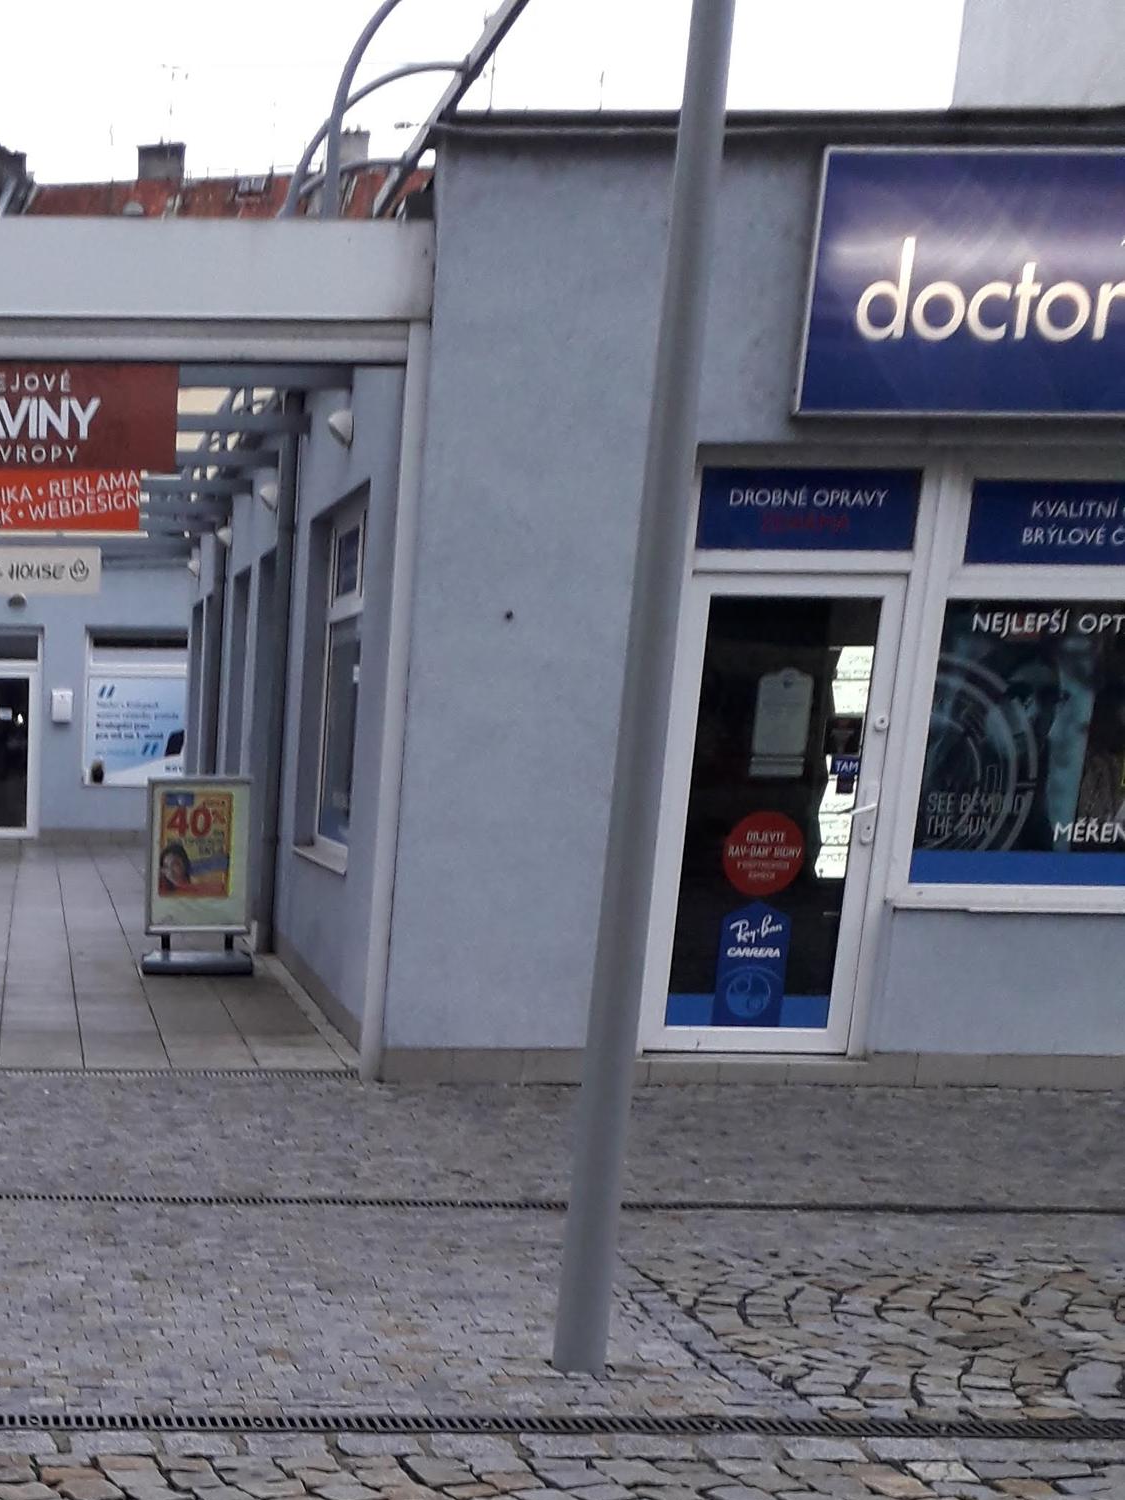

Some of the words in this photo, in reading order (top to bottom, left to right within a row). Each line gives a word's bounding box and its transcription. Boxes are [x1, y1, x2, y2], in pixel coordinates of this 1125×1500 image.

[49, 469, 140, 498] REKLAMA
[29, 491, 140, 522] WEBDESIGN
[729, 484, 807, 507] DROBNÉ
[813, 488, 889, 508] OPRAVY
[1031, 497, 1120, 518] KVALITNÍ
[1021, 523, 1107, 545] BRÝLOVÉ
[8, 562, 65, 580] HOUSE
[972, 608, 1070, 639] NEJLEPŠÍ
[727, 947, 781, 959] CARRERA
